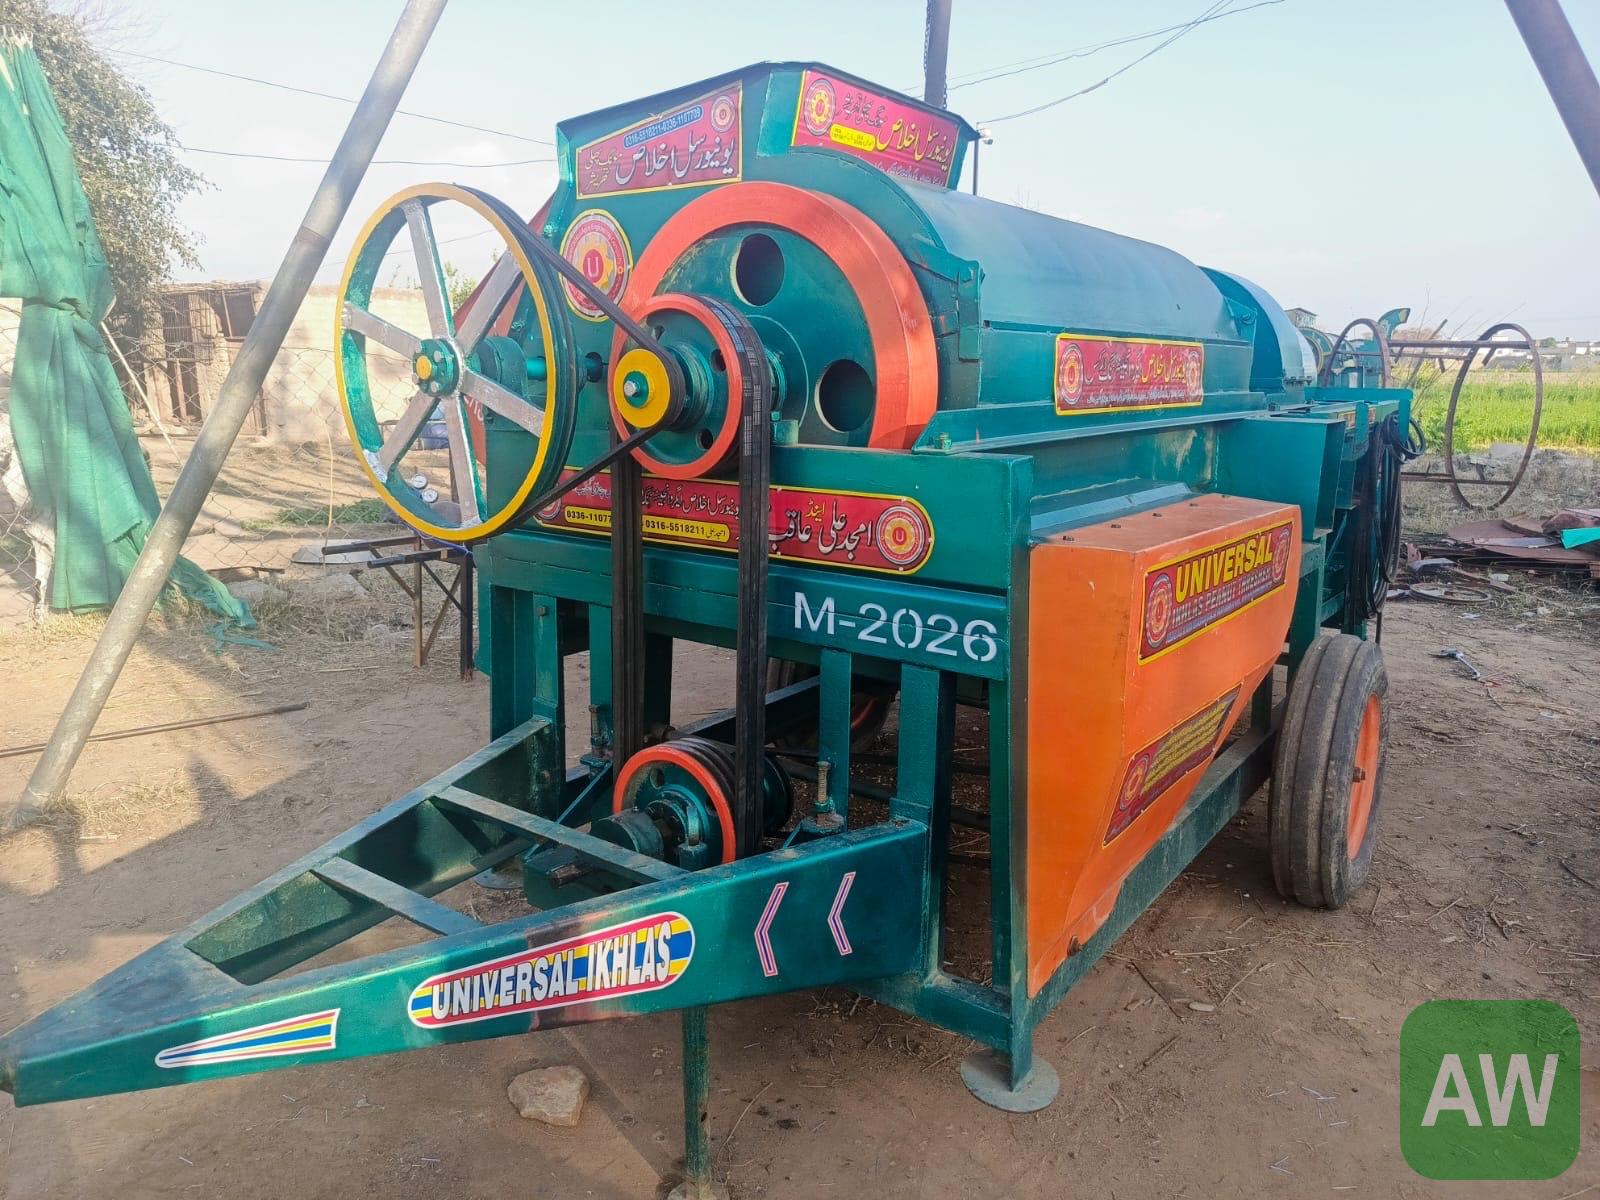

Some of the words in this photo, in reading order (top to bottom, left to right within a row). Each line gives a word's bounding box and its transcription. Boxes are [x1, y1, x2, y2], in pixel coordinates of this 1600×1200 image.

[674, 130, 735, 178] یونیورسل
[876, 118, 919, 150] اخلاص
[914, 121, 953, 171] یونیورسل
[615, 142, 676, 185] اخلاص
[587, 256, 599, 278] U
[682, 494, 711, 514] اخلاص
[645, 519, 705, 535] 0316-5518211
[818, 500, 848, 555] علی
[834, 520, 873, 561] امجد
[895, 529, 905, 542] U
[1175, 533, 1273, 603] UNIVERSAL
[794, 591, 998, 662] M-2026
[431, 948, 580, 1020] UNIVERSAL
[586, 920, 672, 993] IKHLAS
